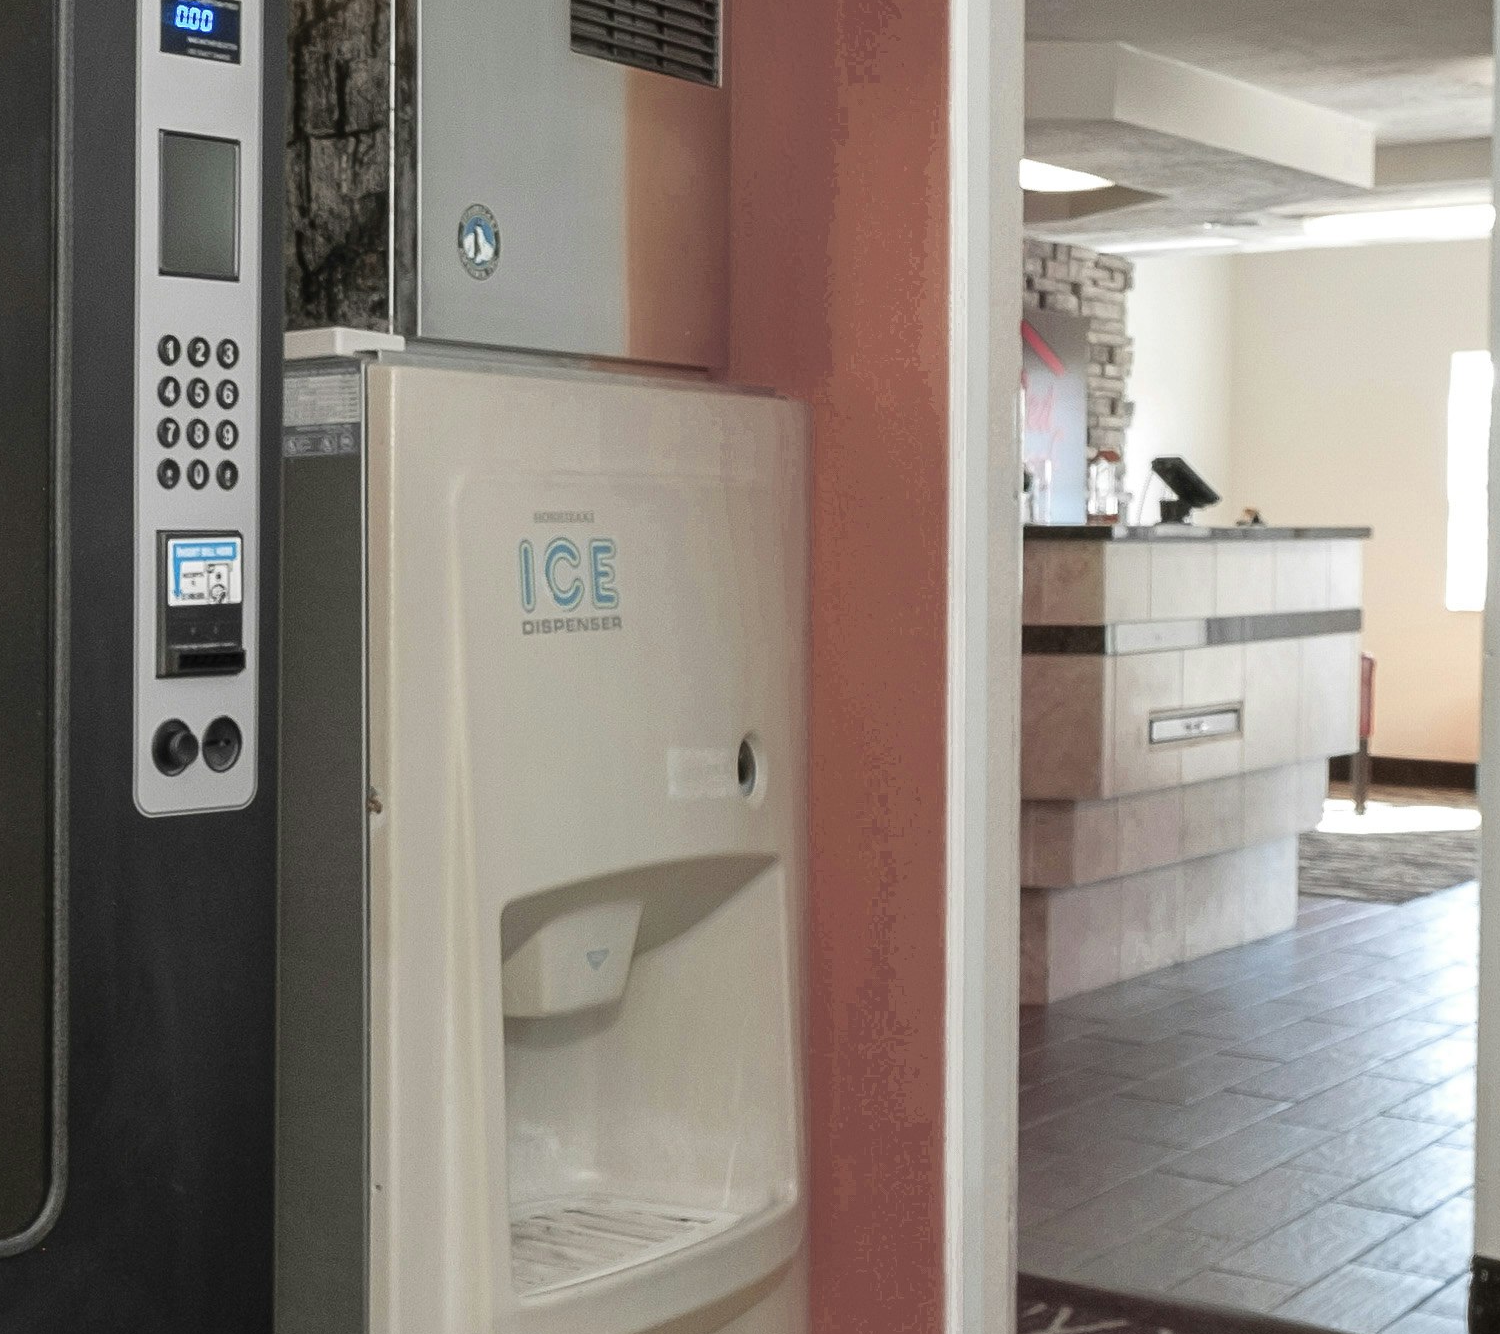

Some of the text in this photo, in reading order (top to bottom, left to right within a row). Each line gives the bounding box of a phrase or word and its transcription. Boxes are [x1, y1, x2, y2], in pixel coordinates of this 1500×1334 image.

[167, 340, 234, 365] 1 2 3
[165, 381, 234, 404] 4 5 6
[166, 422, 234, 445] 7 8 9
[193, 463, 204, 485] 0
[518, 536, 620, 614] ICE
[522, 616, 623, 636] DISPENSER
